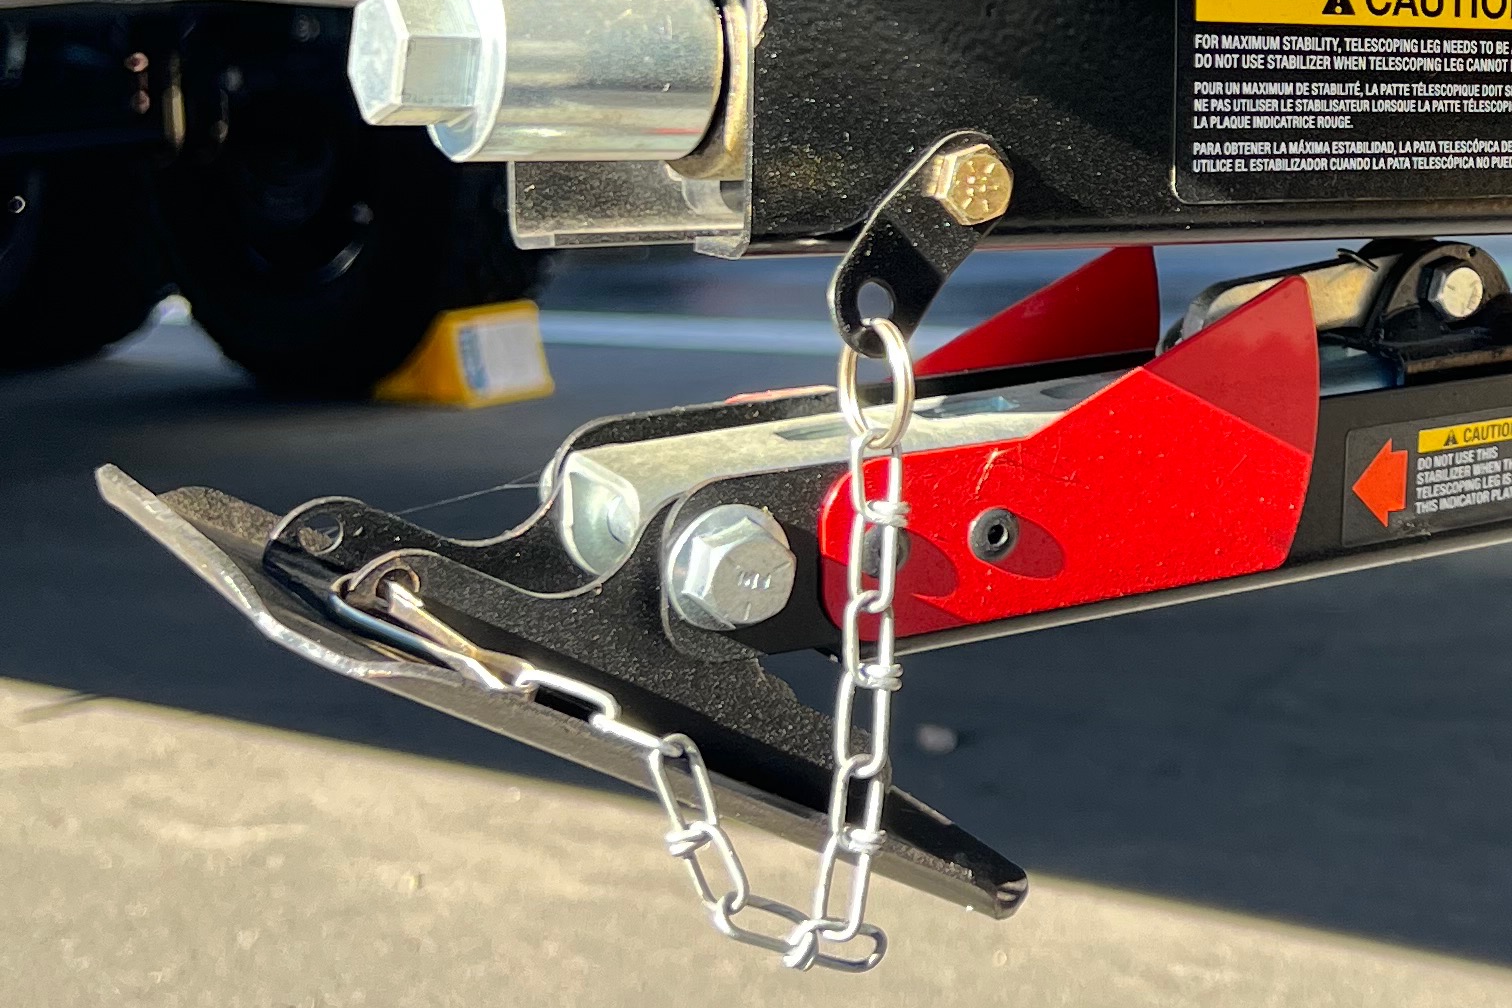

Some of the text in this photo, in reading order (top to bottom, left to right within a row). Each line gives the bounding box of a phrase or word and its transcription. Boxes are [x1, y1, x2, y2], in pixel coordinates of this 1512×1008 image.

[1194, 34, 1219, 50] FOR
[1221, 35, 1281, 51] MAXIMUM
[1282, 36, 1342, 54] STABILITY,
[1344, 37, 1418, 54] TELESCOPING
[1420, 39, 1441, 54] LEG
[1443, 39, 1478, 55] NEEDS
[1479, 40, 1494, 55] TO
[1495, 41, 1509, 55] BE
[1194, 53, 1212, 69] DO
[1215, 54, 1240, 69] NOT
[1241, 55, 1265, 70] USE
[1266, 55, 1332, 70] STABILIZER
[1333, 56, 1366, 70] WHEN
[1368, 56, 1442, 72] TELESCOPING
[1443, 57, 1465, 72] LEG
[1465, 57, 1508, 73] CANNOT
[1193, 81, 1223, 95] POUR
[1224, 82, 1240, 95] UN
[1241, 82, 1294, 96] MAXIMUM
[1295, 83, 1310, 96] DE
[1311, 80, 1364, 98] STABILITÉ,
[1365, 83, 1379, 96] LA
[1380, 83, 1410, 96] PATTE
[1411, 81, 1480, 98] TÉLESCOPIQUE
[1482, 84, 1503, 97] DOIT
[1193, 98, 1209, 112] NE
[1210, 99, 1231, 112] PAS
[1233, 99, 1279, 112] UTILISER
[1280, 99, 1294, 112] LE
[1295, 99, 1370, 113] STABILISATEUR
[1371, 99, 1416, 113] LORSQUE
[1418, 100, 1431, 113] LA
[1432, 100, 1461, 113] PATTE
[1193, 116, 1354, 129] LA PLAQUE INDICATRICE ROUGE.
[1193, 142, 1222, 156] PARA
[1223, 142, 1271, 156] OBTENER
[1273, 141, 1287, 155] LA
[1288, 139, 1330, 155] MÁXIMA
[1331, 141, 1397, 156] ESTABILIDAD,
[1399, 140, 1412, 153] LA
[1413, 140, 1437, 153] PATA
[1438, 138, 1500, 153] TELESCÓPICA
[1192, 159, 1233, 173] UTILICE
[1234, 159, 1248, 172] EL
[1249, 158, 1328, 172] ESTABILIZADOR
[1329, 157, 1370, 171] CUANDO
[1372, 157, 1386, 170] LA
[1387, 157, 1411, 170] PATA
[1412, 154, 1474, 169] TELESCÓPICA
[1476, 156, 1490, 169] NO
[1417, 445, 1499, 471] DO NOT USE THIS
[1416, 465, 1472, 486] STABILIZER
[1471, 459, 1501, 476] WHEN
[1416, 477, 1482, 500] TELESCOPING
[1482, 474, 1501, 490] LEG
[1501, 472, 1512, 485] IS
[1415, 498, 1439, 515] THIS
[1439, 490, 1490, 511] INDICATOR
